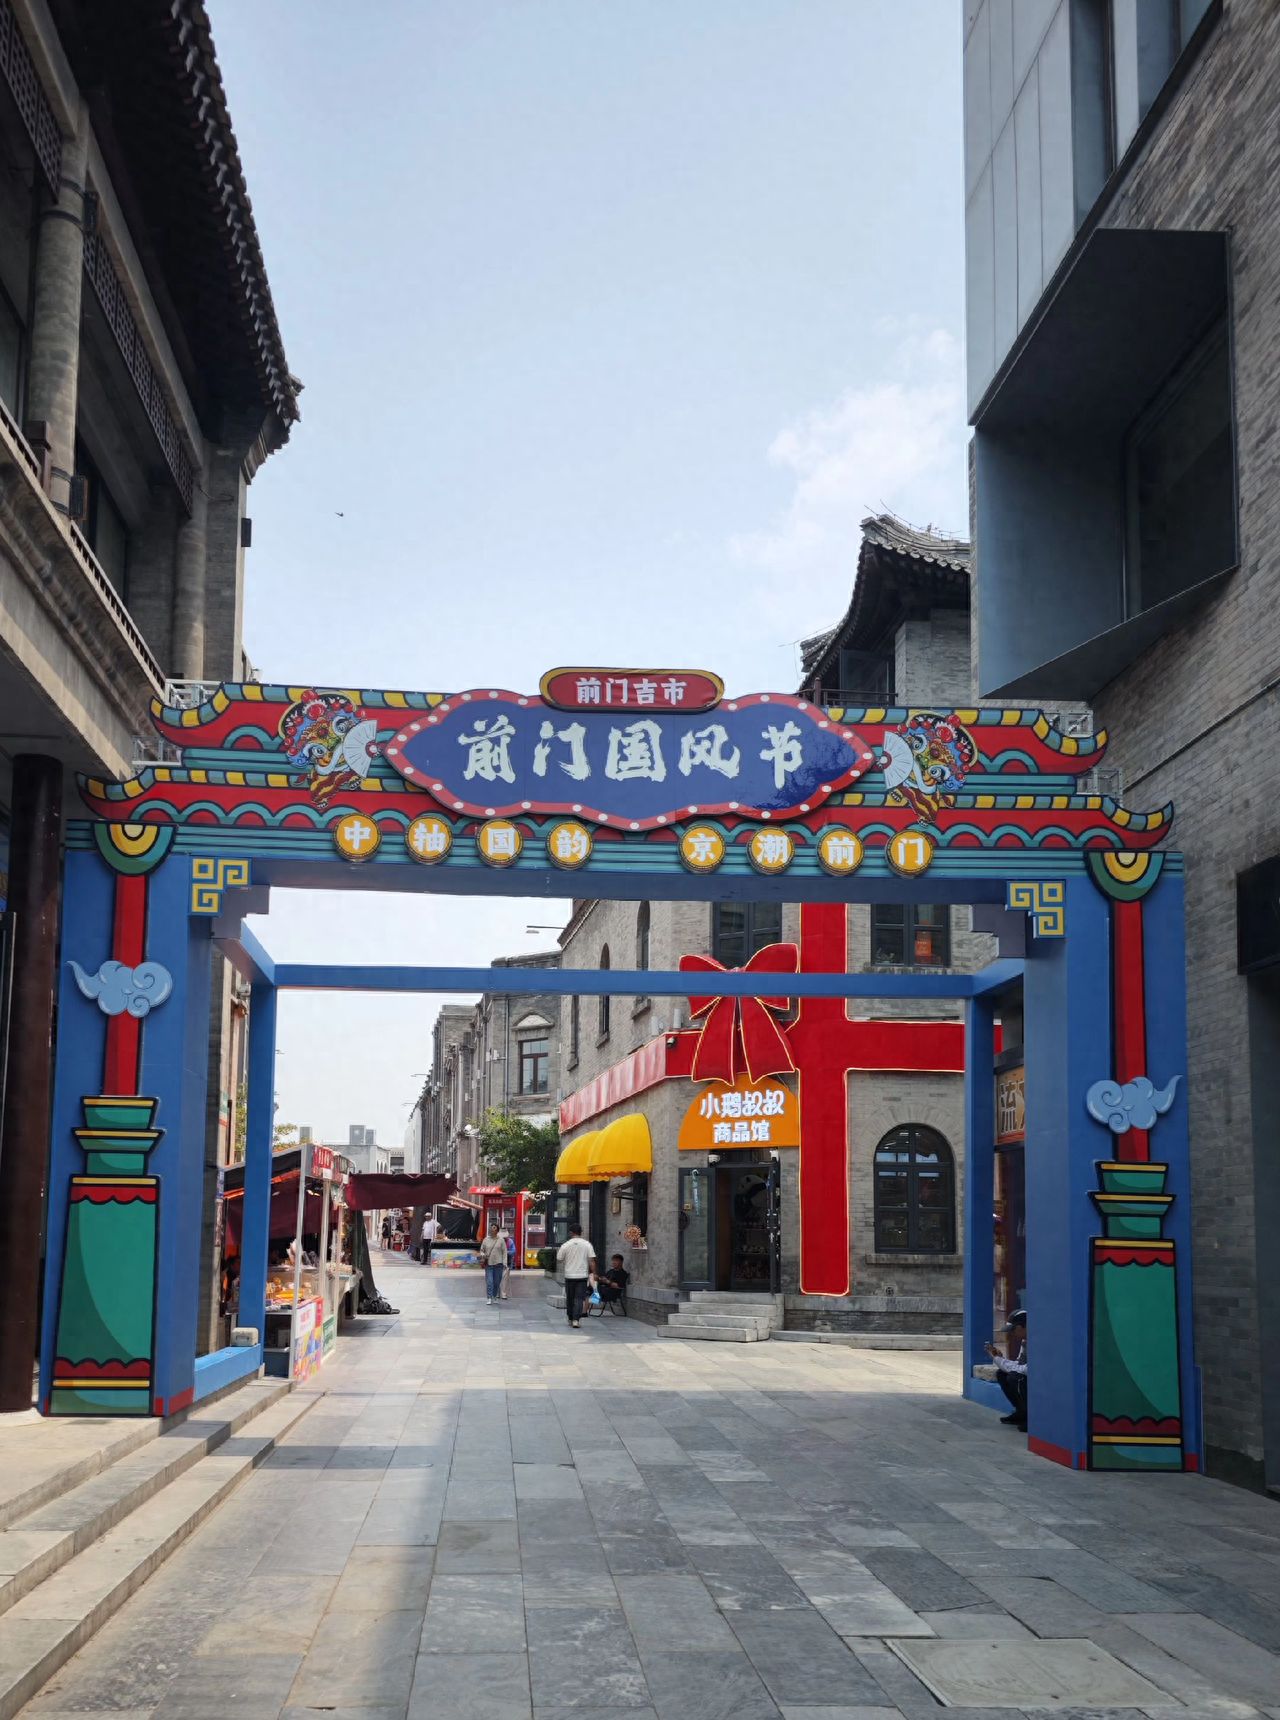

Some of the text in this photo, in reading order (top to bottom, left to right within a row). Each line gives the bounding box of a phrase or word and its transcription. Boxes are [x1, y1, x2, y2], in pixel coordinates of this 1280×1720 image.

[575, 677, 687, 706] 前门吉市
[458, 714, 804, 789] 前门国风节
[713, 1119, 770, 1144] 商品馆
